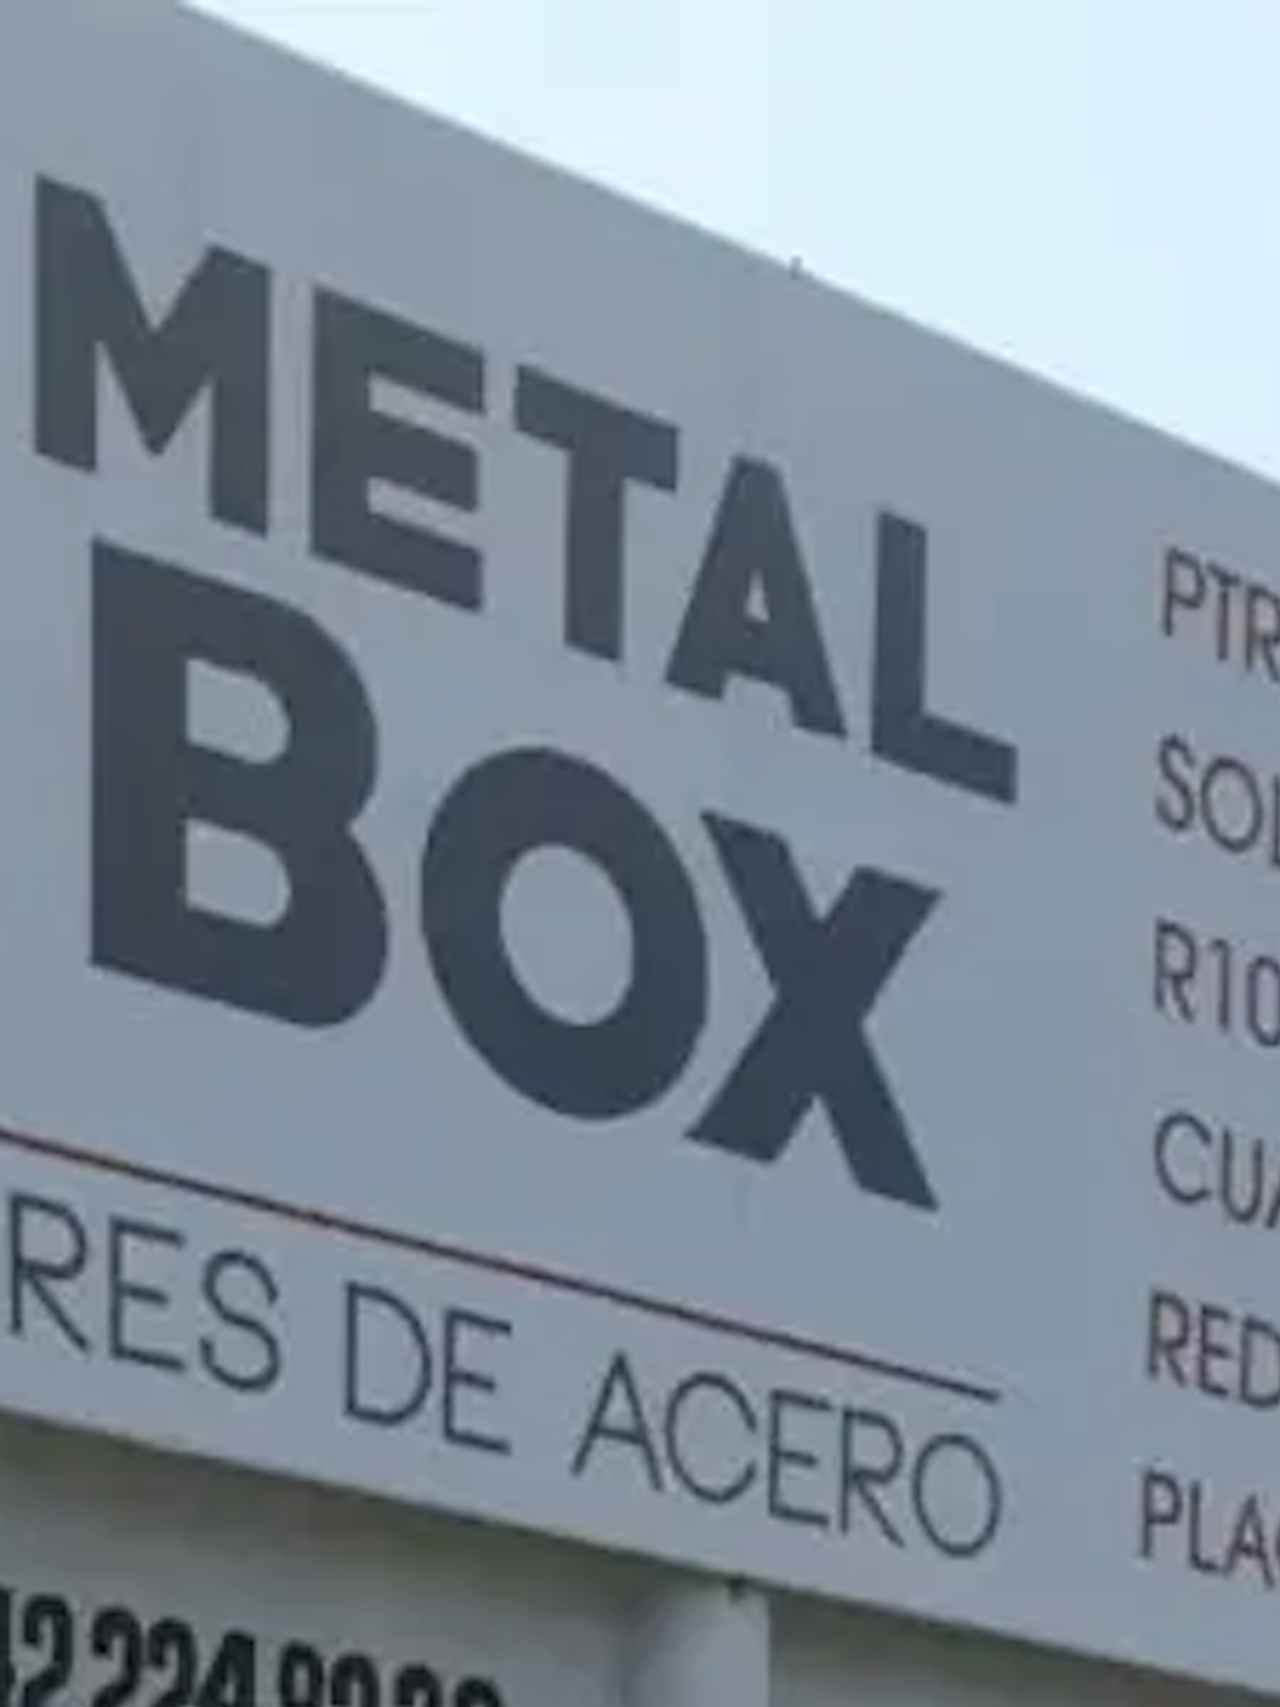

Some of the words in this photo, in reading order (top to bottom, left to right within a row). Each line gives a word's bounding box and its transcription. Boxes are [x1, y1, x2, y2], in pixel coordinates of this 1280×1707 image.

[33, 172, 1019, 805] METAL
[89, 535, 943, 1212] BOX
[342, 1280, 515, 1457] DE
[571, 1353, 1004, 1560] ACERO
